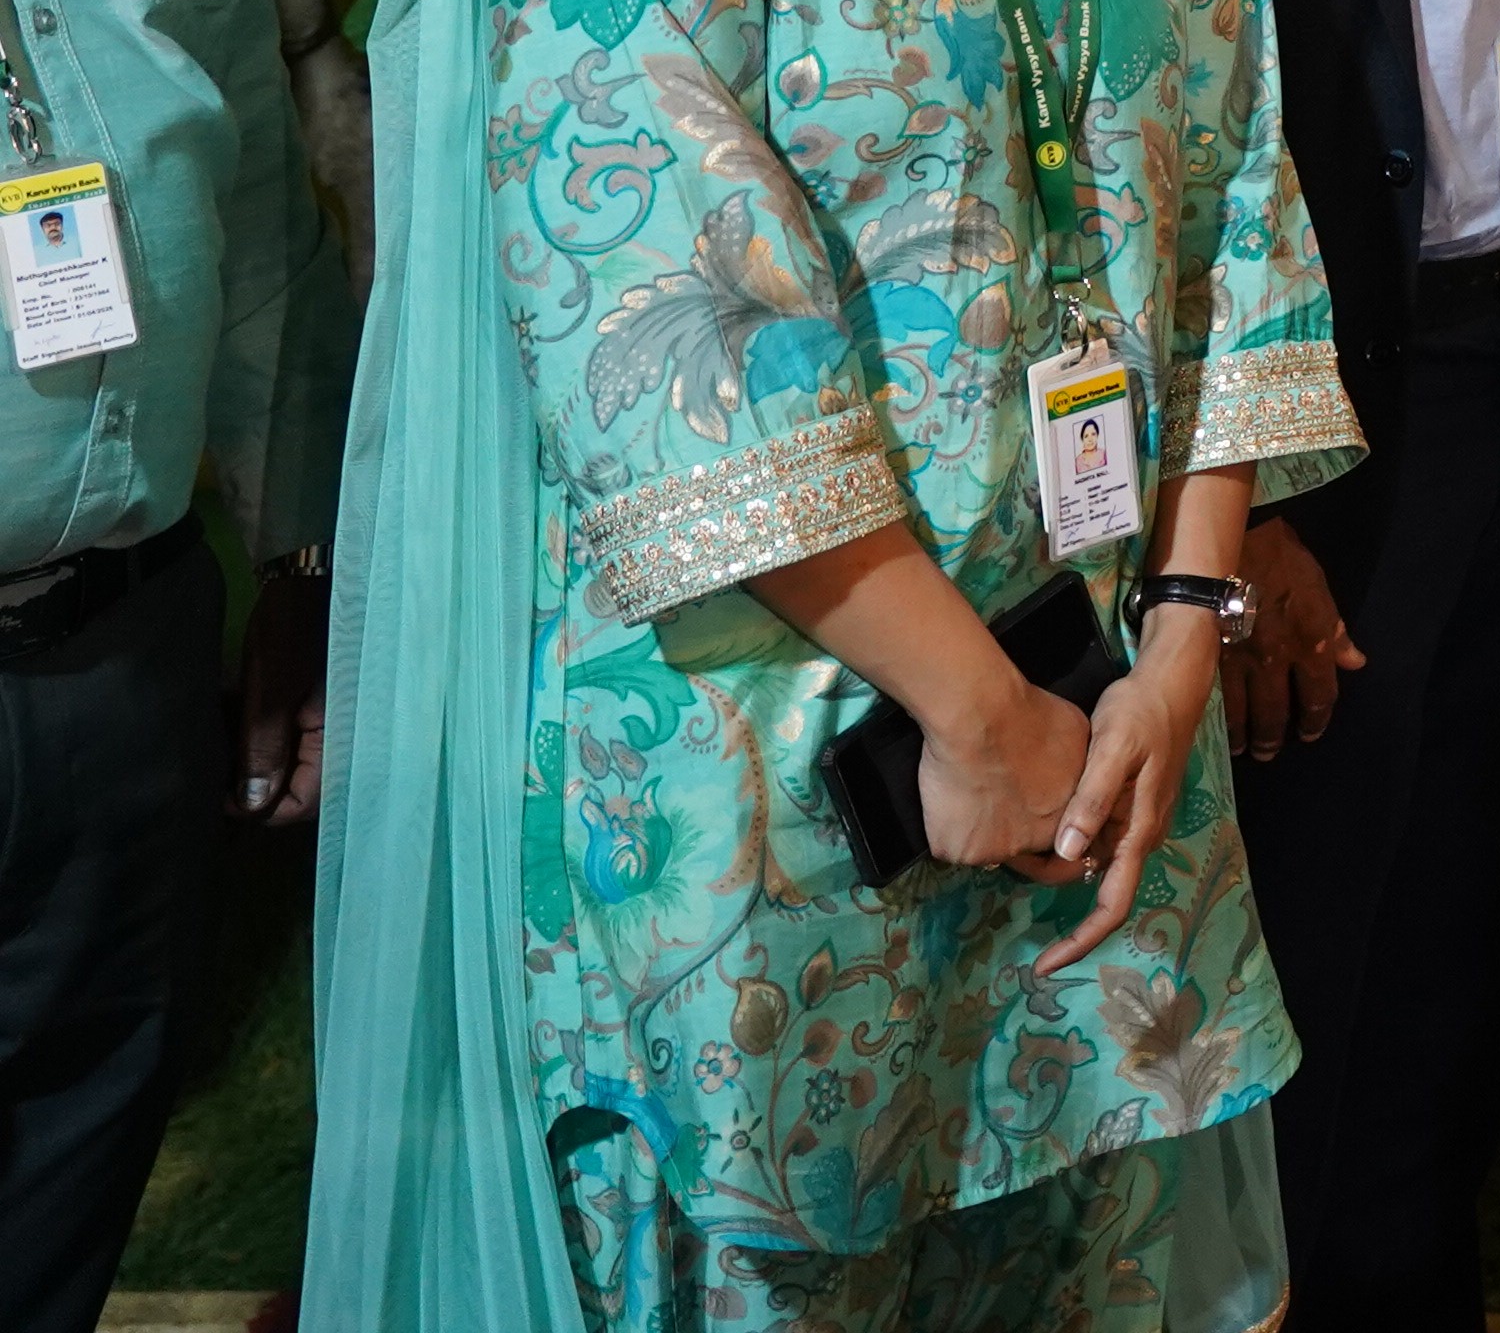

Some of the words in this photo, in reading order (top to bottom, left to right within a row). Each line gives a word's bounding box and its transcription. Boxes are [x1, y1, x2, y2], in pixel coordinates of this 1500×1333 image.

[1013, 7, 1031, 44] Bank
[1079, 1, 1090, 37] Bank
[1025, 44, 1044, 88] Vysya
[1077, 39, 1091, 82] Vysya
[1035, 88, 1051, 129] Karur
[1068, 83, 1084, 123] Karur
[78, 176, 100, 187] Bank
